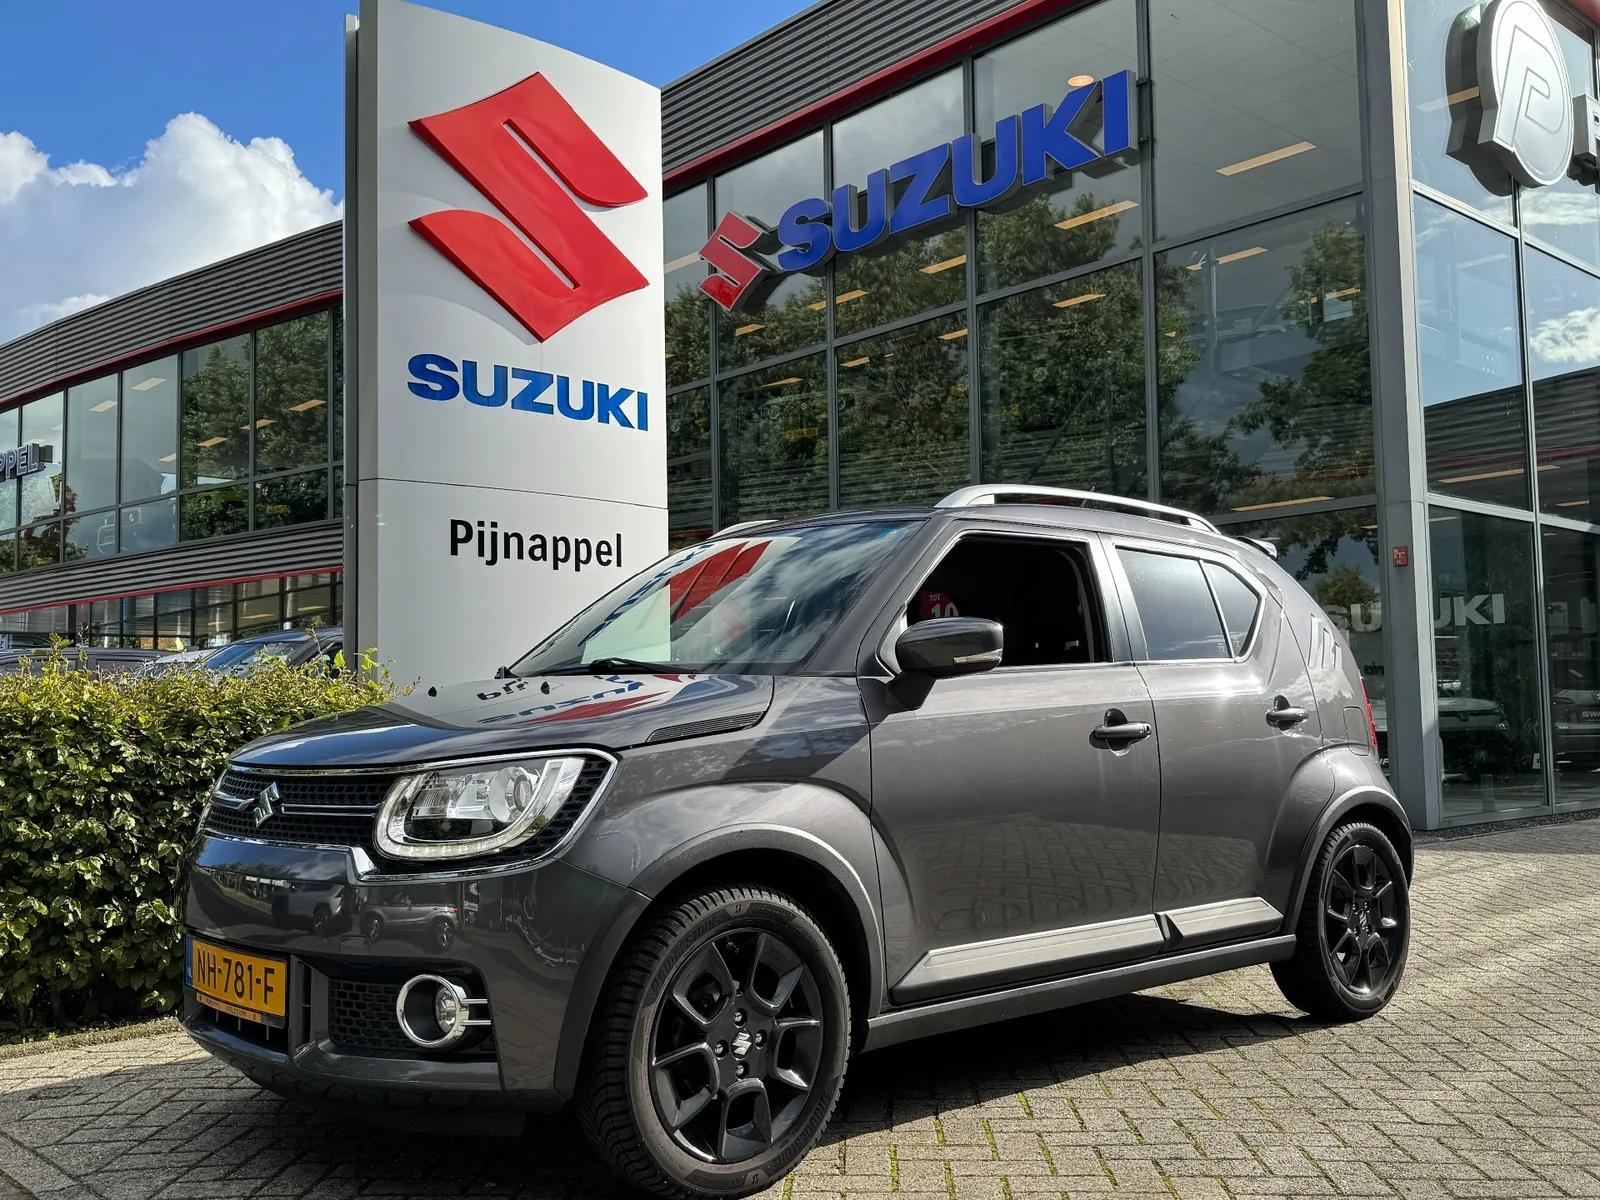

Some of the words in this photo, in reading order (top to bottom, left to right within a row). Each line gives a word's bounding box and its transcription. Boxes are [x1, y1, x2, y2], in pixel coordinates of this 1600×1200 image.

[775, 69, 1136, 273] SUZUKI
[407, 353, 648, 432] SUZUKI
[450, 518, 622, 572] Pijnappel
[928, 593, 941, 601] TOT
[196, 947, 275, 1005] NH-781-F
